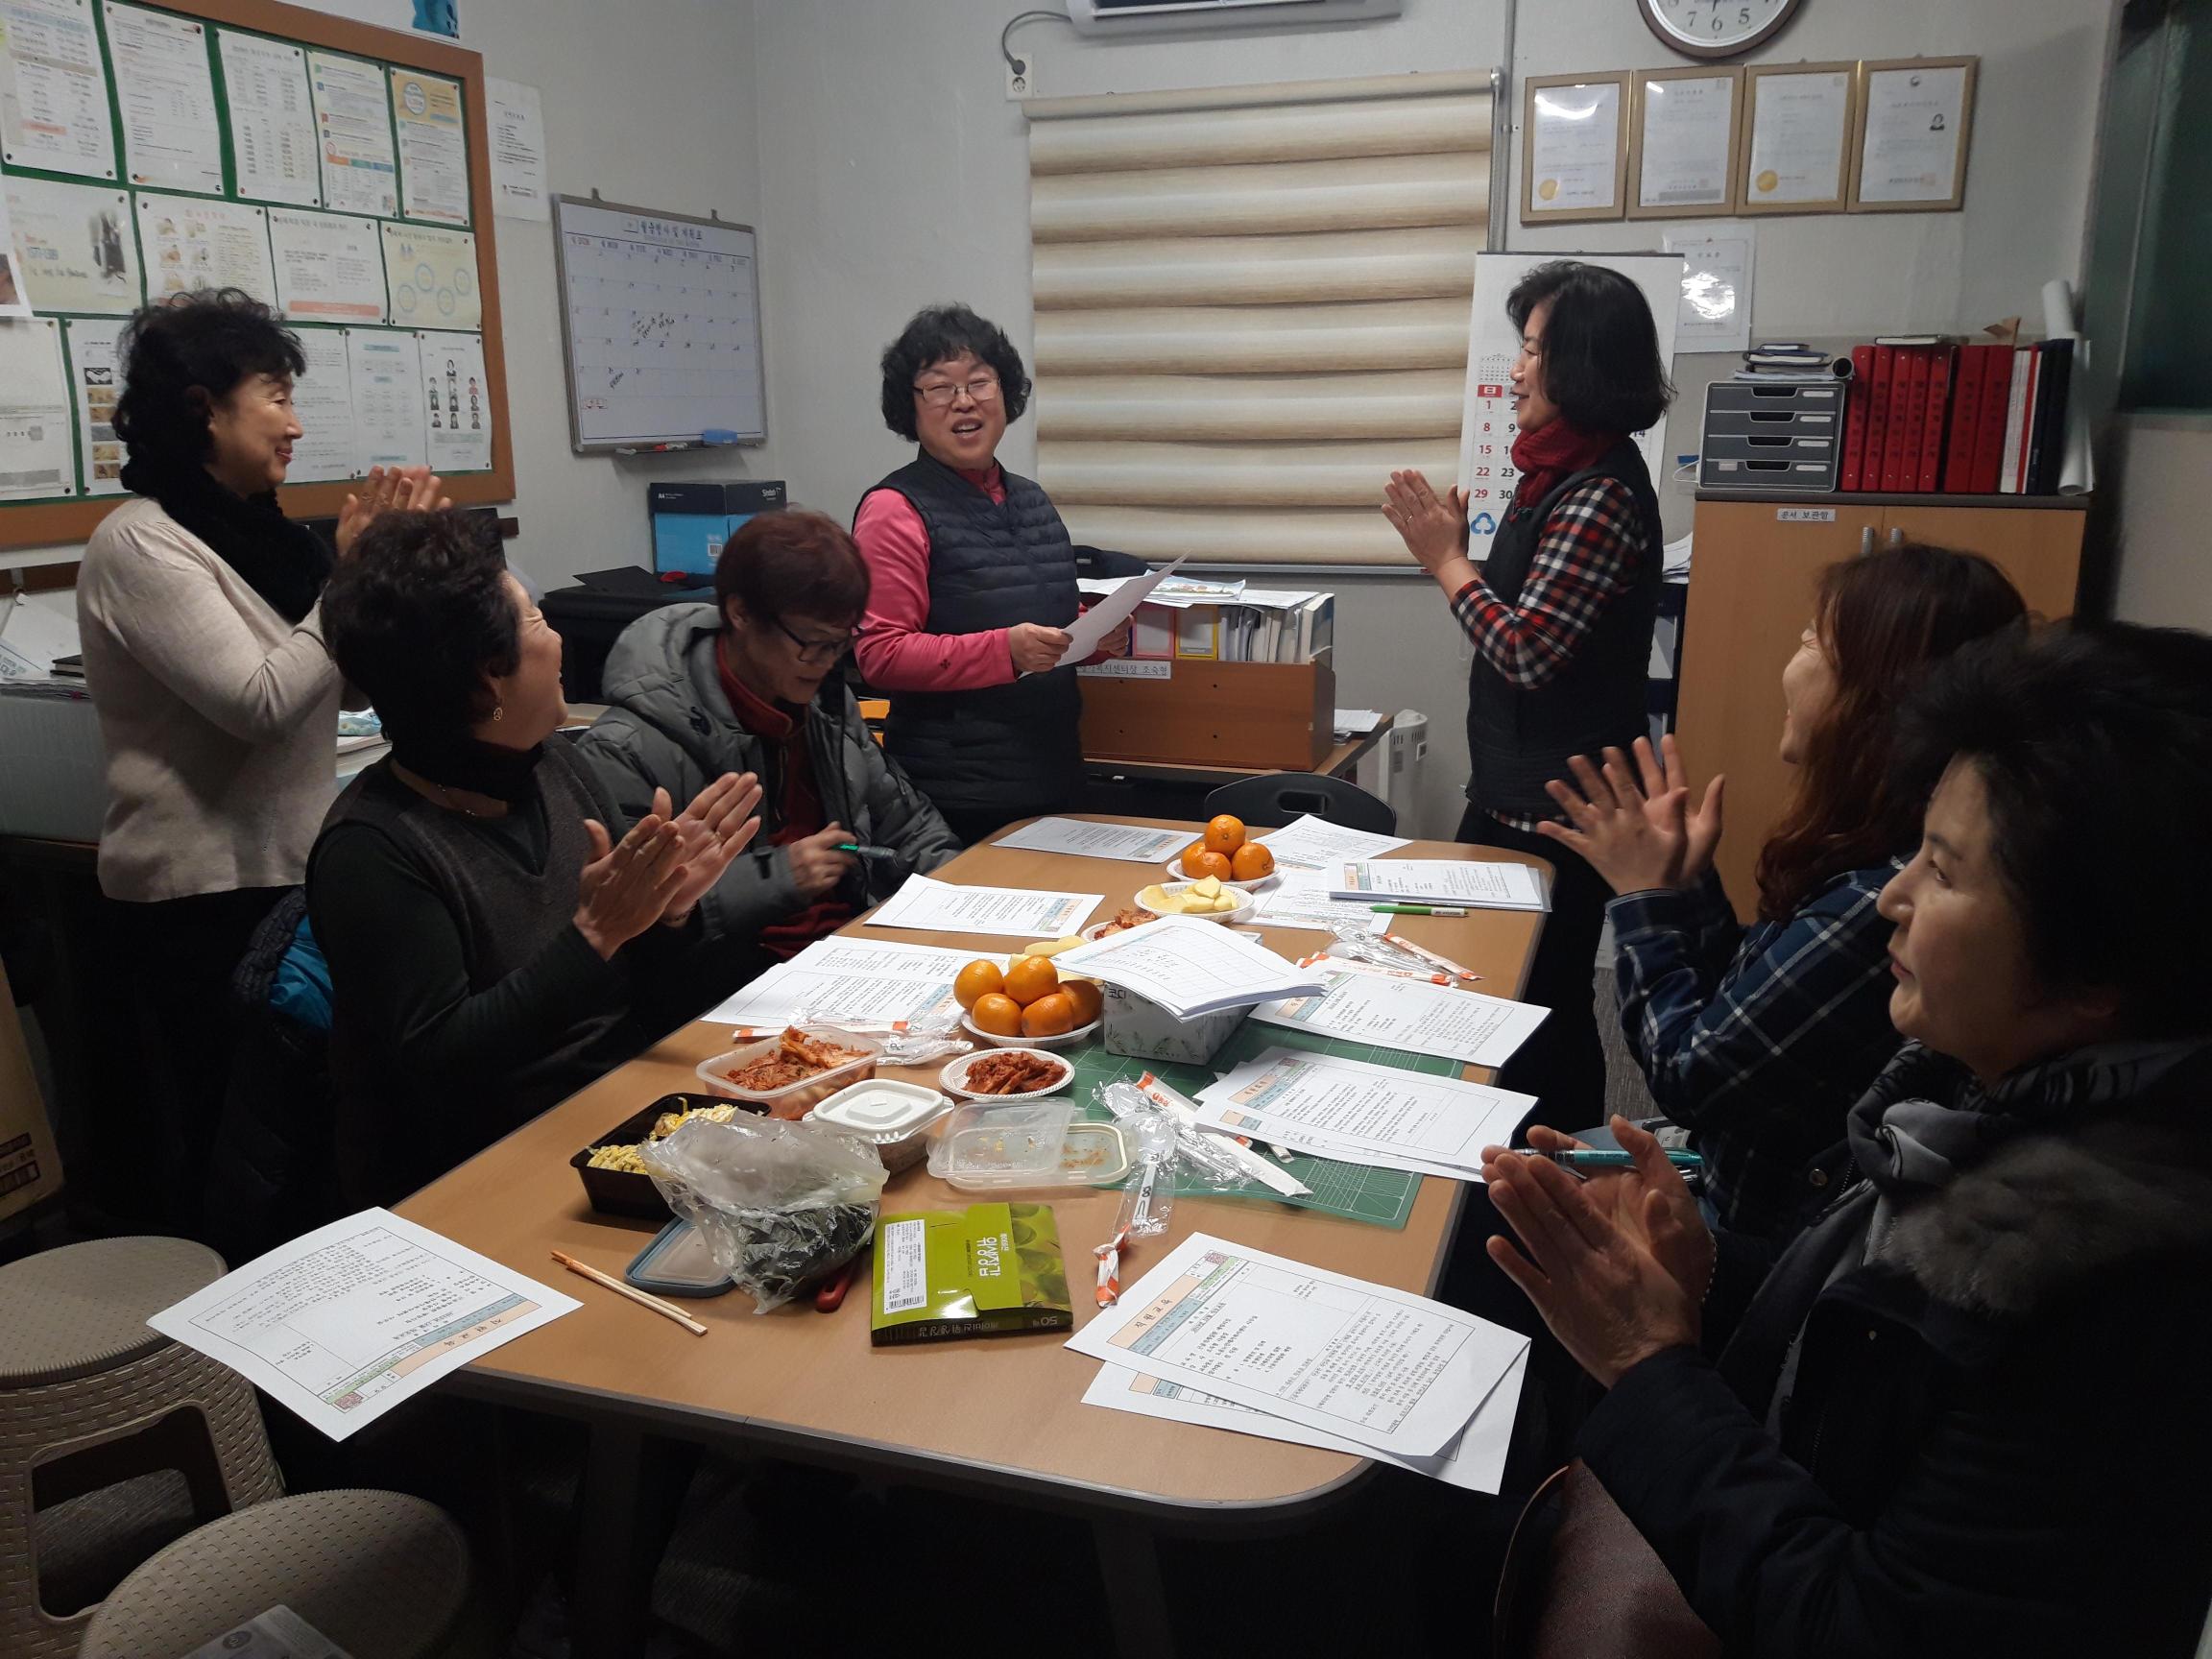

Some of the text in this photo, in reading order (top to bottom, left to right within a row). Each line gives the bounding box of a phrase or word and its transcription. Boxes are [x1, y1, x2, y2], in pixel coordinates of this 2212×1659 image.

[1688, 12, 1697, 27] 7
[1712, 16, 1722, 31] 6
[1739, 9, 1750, 24] 5
[1508, 423, 1515, 432] 9
[1479, 445, 1491, 454] 15
[1477, 468, 1514, 477] 22 23
[1475, 490, 1512, 499] 29 30
[977, 1237, 1001, 1277] 위생장갑
[1134, 1298, 1173, 1328] 직원교육
